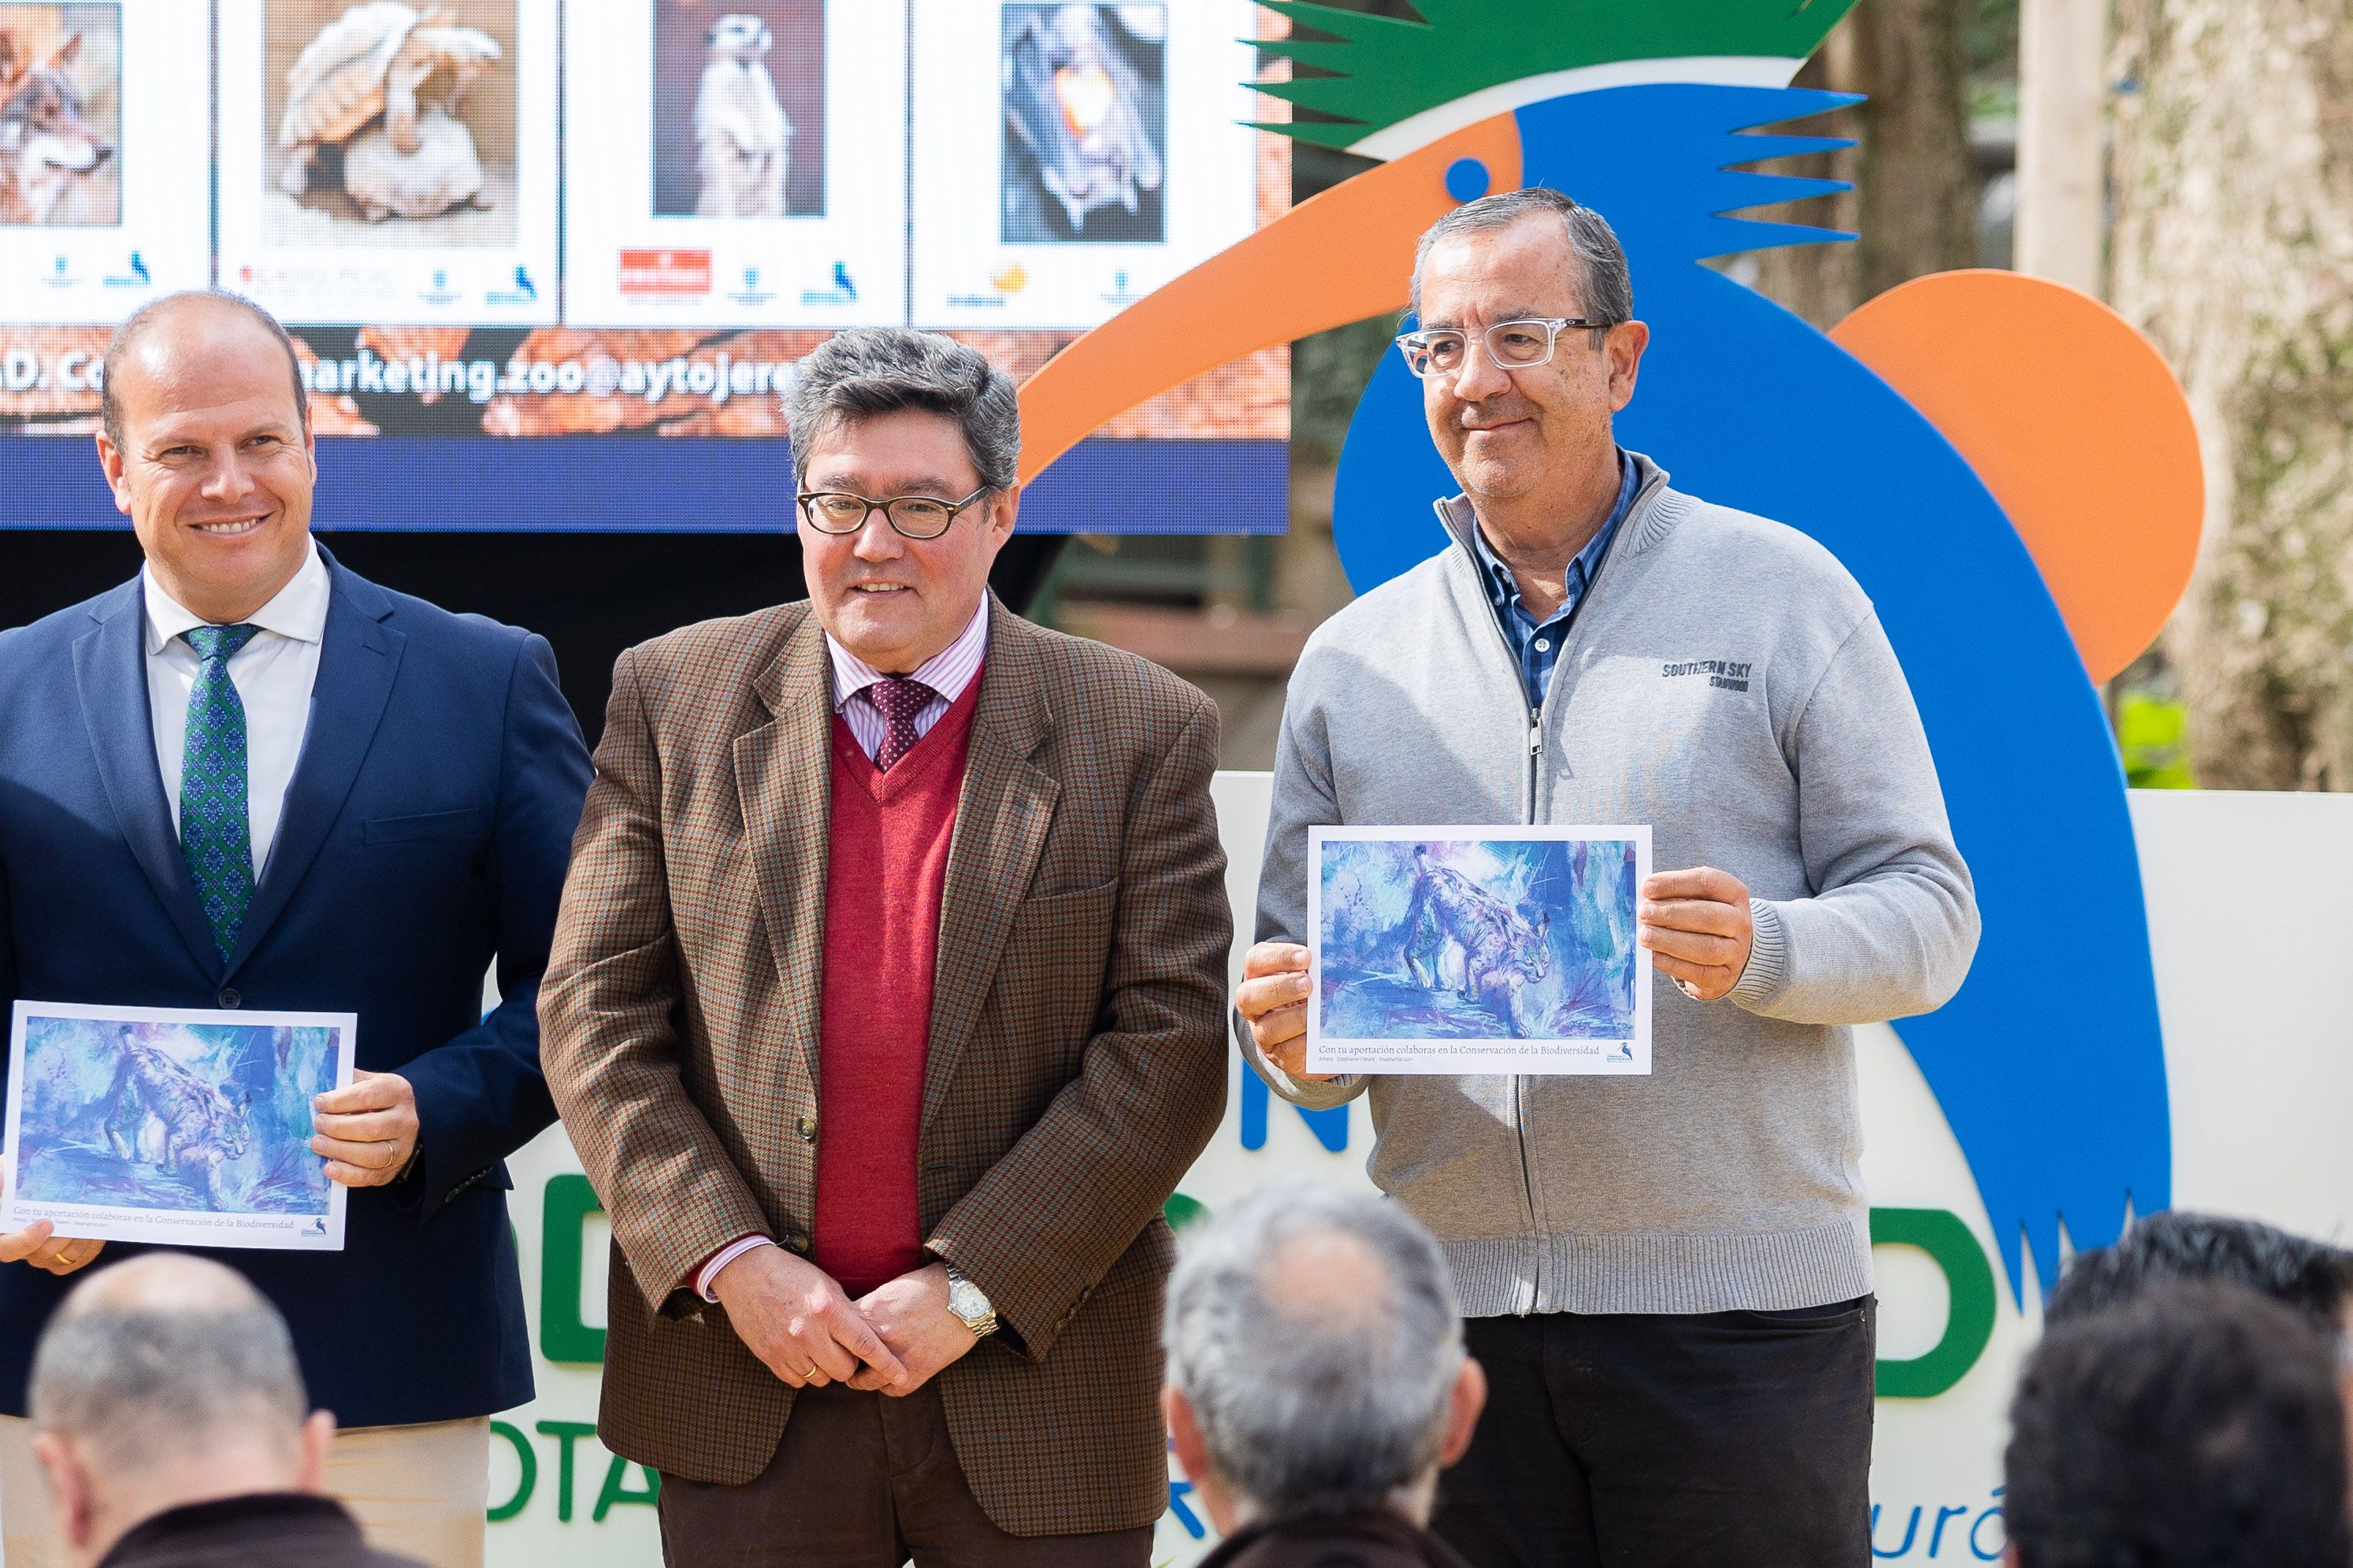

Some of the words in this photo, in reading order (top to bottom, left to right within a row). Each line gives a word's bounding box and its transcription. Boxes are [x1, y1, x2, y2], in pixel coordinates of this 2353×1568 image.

[1662, 660, 1726, 677] SOUTHERN
[1728, 662, 1752, 677] SKY
[1319, 1045, 1336, 1054] Con
[1349, 1045, 1394, 1055] aportación
[1397, 1045, 1436, 1054] colaboras
[1460, 1046, 1516, 1055] Conservación
[1519, 1046, 1529, 1055] de
[1531, 1046, 1538, 1055] la
[1541, 1046, 1599, 1055] Biodiversidad
[44, 1209, 90, 1218] aportación
[91, 1211, 132, 1221] colaboras
[146, 1214, 153, 1223] la
[155, 1216, 212, 1227] Conservación
[214, 1218, 225, 1227] de
[227, 1219, 234, 1228] la
[236, 1219, 295, 1229] Biodiversidad
